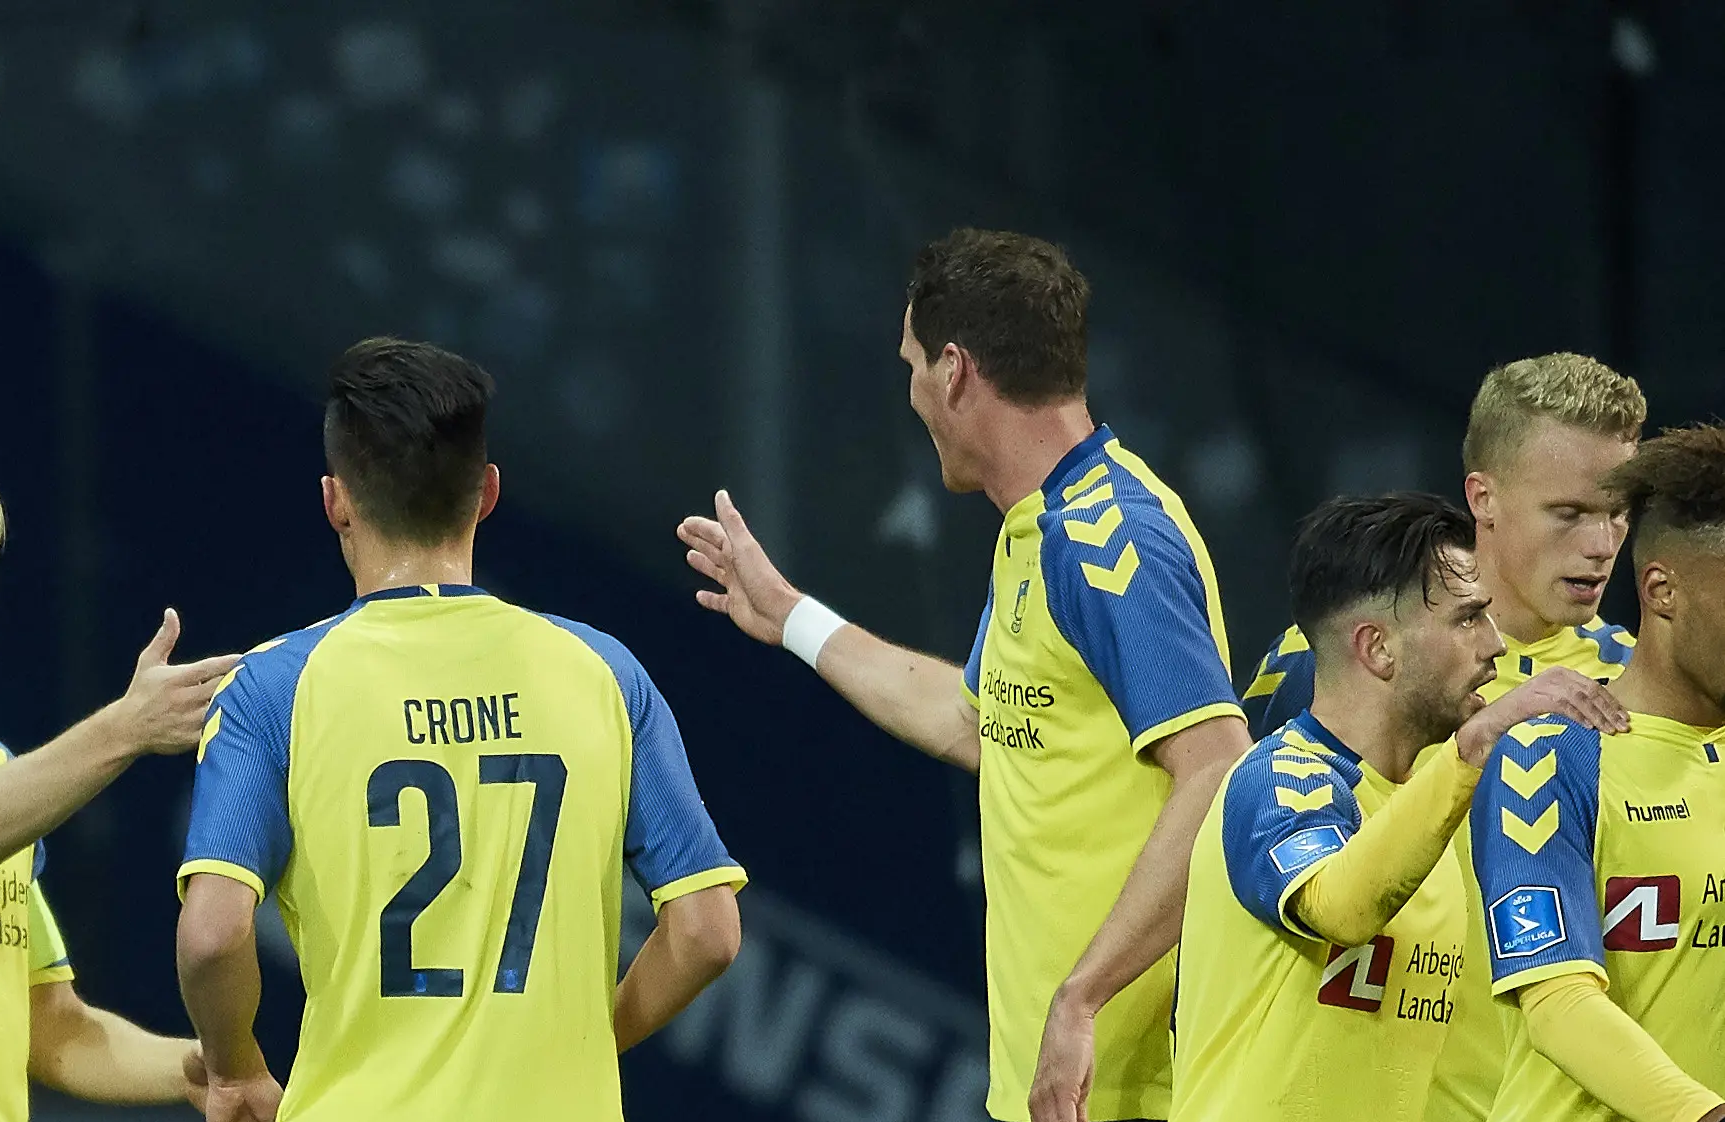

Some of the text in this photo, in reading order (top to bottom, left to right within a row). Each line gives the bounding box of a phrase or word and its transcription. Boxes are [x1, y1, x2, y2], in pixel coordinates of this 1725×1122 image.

[403, 692, 523, 745] CRONE
[1625, 797, 1692, 823] hummel
[366, 754, 568, 997] 27
